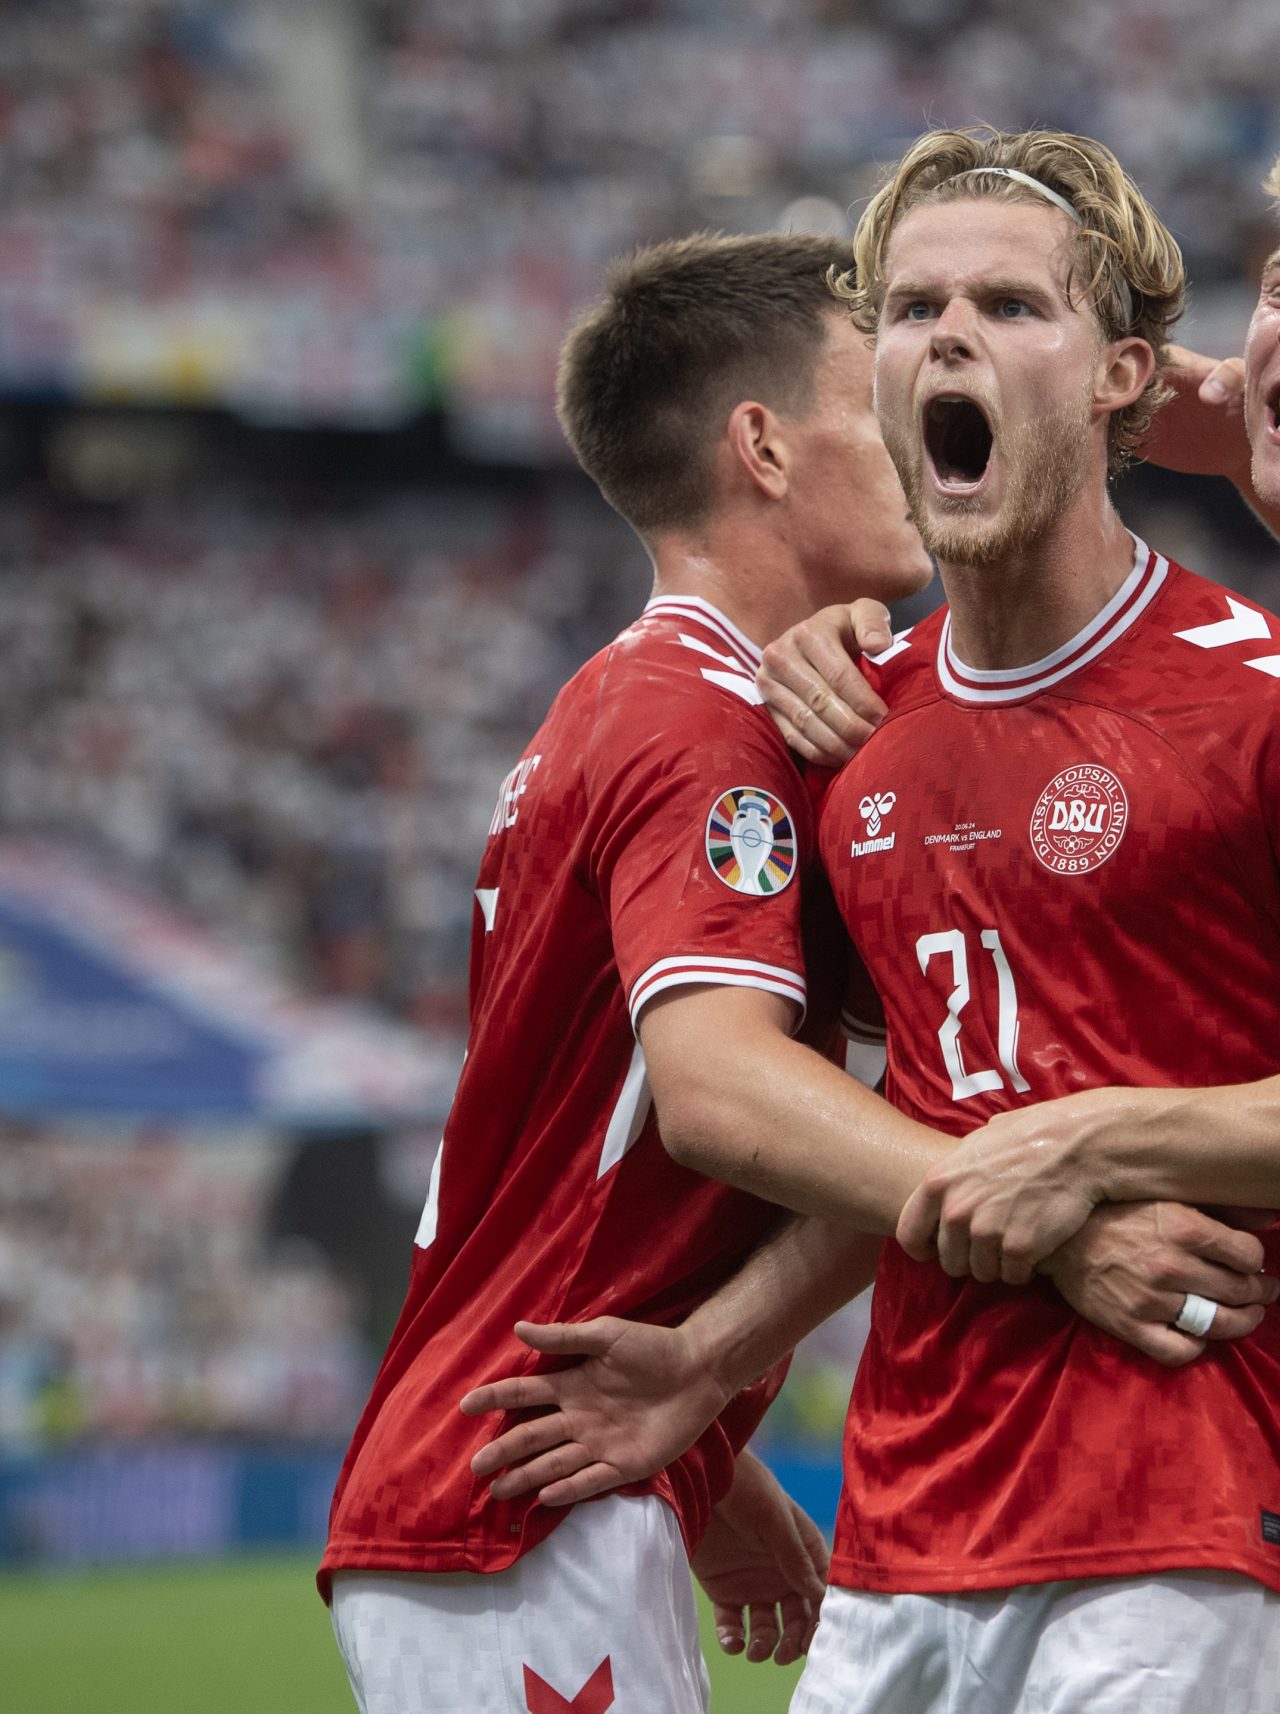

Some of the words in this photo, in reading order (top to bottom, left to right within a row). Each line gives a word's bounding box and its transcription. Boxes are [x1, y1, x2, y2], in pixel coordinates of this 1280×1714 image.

[1033, 793, 1053, 858] DANSK
[1048, 800, 1108, 833] DBU
[851, 831, 896, 858] hummel
[924, 834, 961, 845] DENMARK
[969, 829, 1002, 841] ENGLAND
[949, 843, 976, 852] FRANKFURT
[1050, 856, 1090, 872] 1889
[916, 929, 1031, 1101] 21
